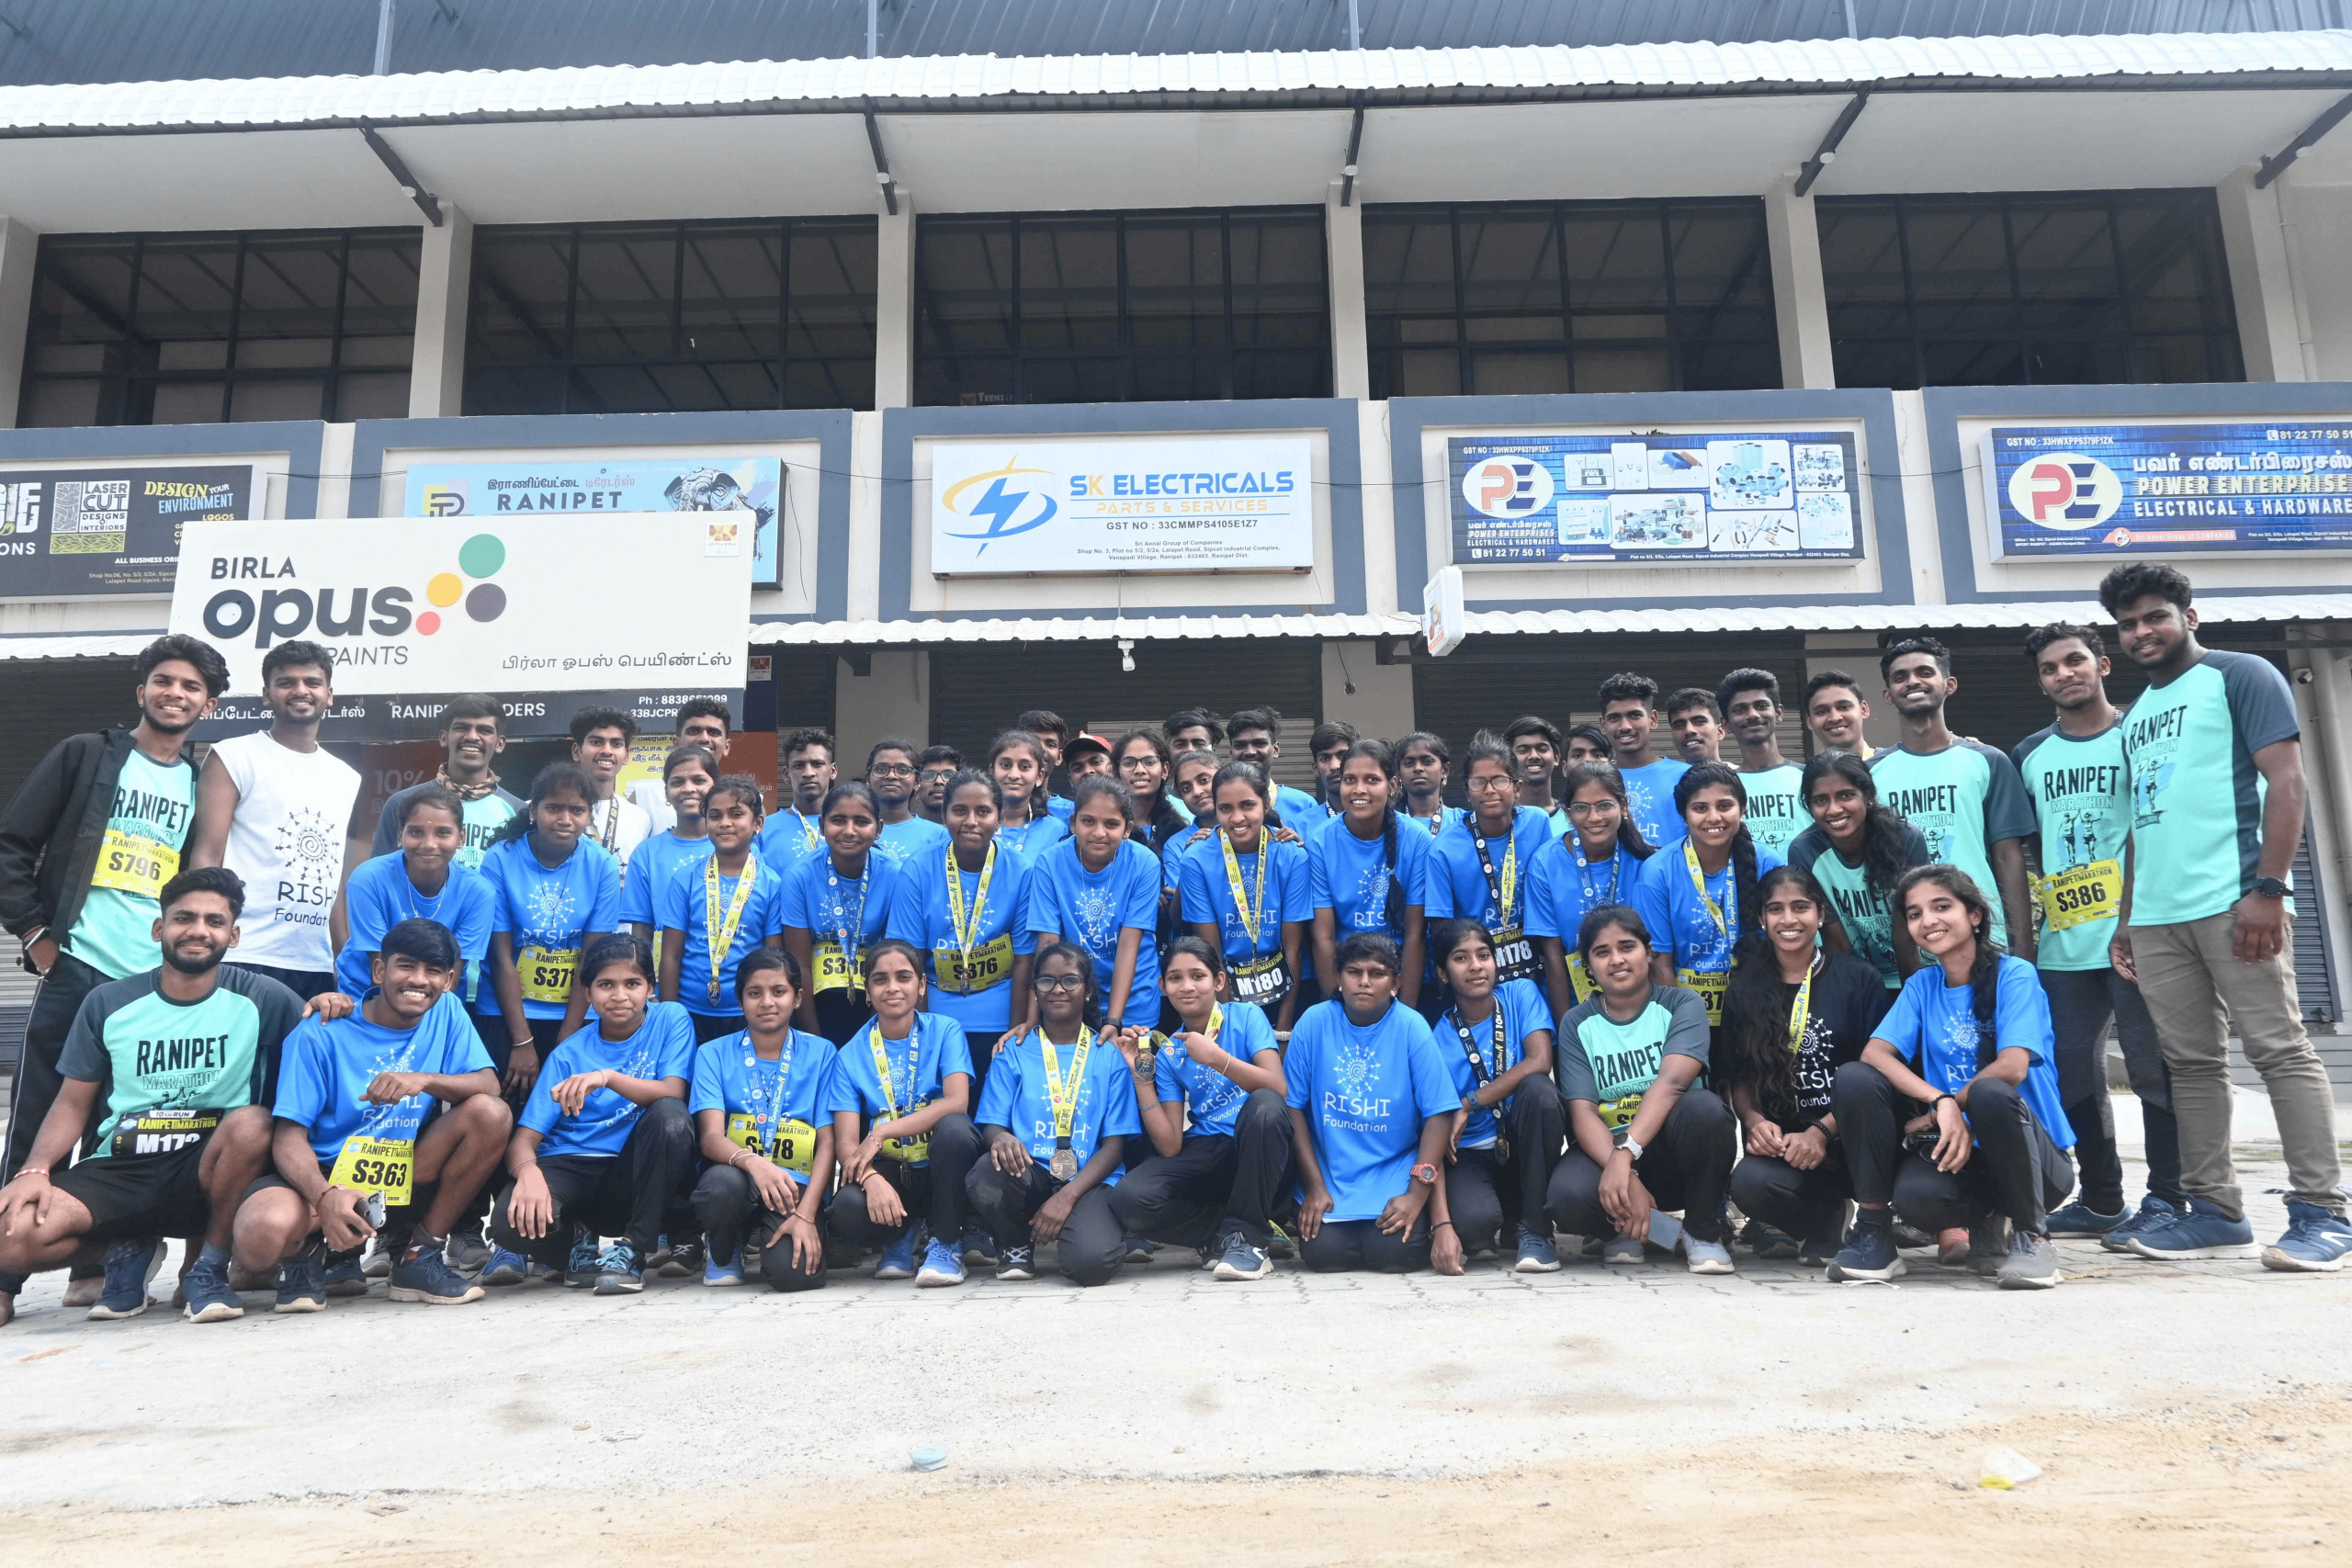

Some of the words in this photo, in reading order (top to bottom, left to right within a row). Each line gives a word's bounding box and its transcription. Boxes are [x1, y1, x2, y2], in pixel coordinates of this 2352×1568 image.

[2007, 437, 2023, 446] GST
[2024, 437, 2037, 446] NO
[2279, 431, 2291, 440] 81
[2294, 431, 2308, 439] 22
[2311, 431, 2323, 439] 77
[2326, 430, 2339, 439] 50
[2132, 452, 2181, 472] பவர்
[85, 482, 128, 494] LASER
[143, 480, 209, 498] DESIGN
[209, 483, 230, 495] YOUR
[1069, 475, 1105, 496] SK
[1114, 471, 1295, 495] ELECTRICALS
[2135, 476, 2210, 496] POWER
[83, 493, 127, 511] CUT
[158, 492, 234, 514] ENVIRONMENT
[497, 491, 623, 512] RANIPET
[1096, 501, 1156, 514] PARTS
[1163, 501, 1172, 513] &
[1180, 499, 1268, 513] SERVICES
[2133, 499, 2238, 517] ELECTRICAL
[2245, 499, 2256, 515] &
[82, 513, 126, 521] DESIGNS
[1106, 521, 1128, 530] GST
[1132, 521, 1148, 530] NO
[1158, 519, 1259, 529] 33CMMPS4105E1Z7
[1467, 538, 1507, 547] ELECTRICAL
[1515, 537, 1555, 546] HARDWARES
[1468, 530, 1498, 538] POWER
[1499, 529, 1555, 537] ENTERPRISES
[1483, 548, 1493, 558] 81
[1495, 548, 1507, 557] 22
[1510, 548, 1520, 557] 77
[1521, 548, 1533, 557] 50
[1535, 547, 1546, 557] 51
[210, 557, 297, 580] BIRLA
[203, 586, 413, 649] opus
[502, 654, 558, 671] பிர்லா
[562, 653, 613, 671] ஓபஸ்
[617, 651, 732, 668] பெயிண்ட்ஸ்
[639, 695, 652, 705] Ph
[2129, 705, 2188, 755] RANIPET
[373, 769, 425, 795] 10%
[2044, 765, 2120, 803] RANIPET
[110, 784, 189, 834] RANIPET
[1888, 784, 1958, 818] RANIPET
[2051, 795, 2115, 814] MARATHON
[112, 836, 145, 852] RANIPET
[108, 851, 162, 881] S796
[2052, 874, 2078, 889] RANIPET
[2055, 881, 2107, 913] S386
[1354, 910, 1387, 927] RIS
[535, 952, 564, 964] RANIPET
[953, 956, 999, 981] S376
[1236, 967, 1283, 996] M180
[1688, 976, 1715, 987] RANIPET
[136, 1034, 229, 1077] RANIPET
[1594, 1041, 1664, 1091] RANIPET
[1200, 1084, 1248, 1115] RISHI
[1324, 1091, 1391, 1118] RISHI
[137, 1117, 178, 1130] RANIPET
[177, 1119, 217, 1130] MARATHON
[1323, 1114, 1388, 1134] Foundation
[360, 1142, 398, 1157] RANIPET
[351, 1158, 408, 1187] S363
